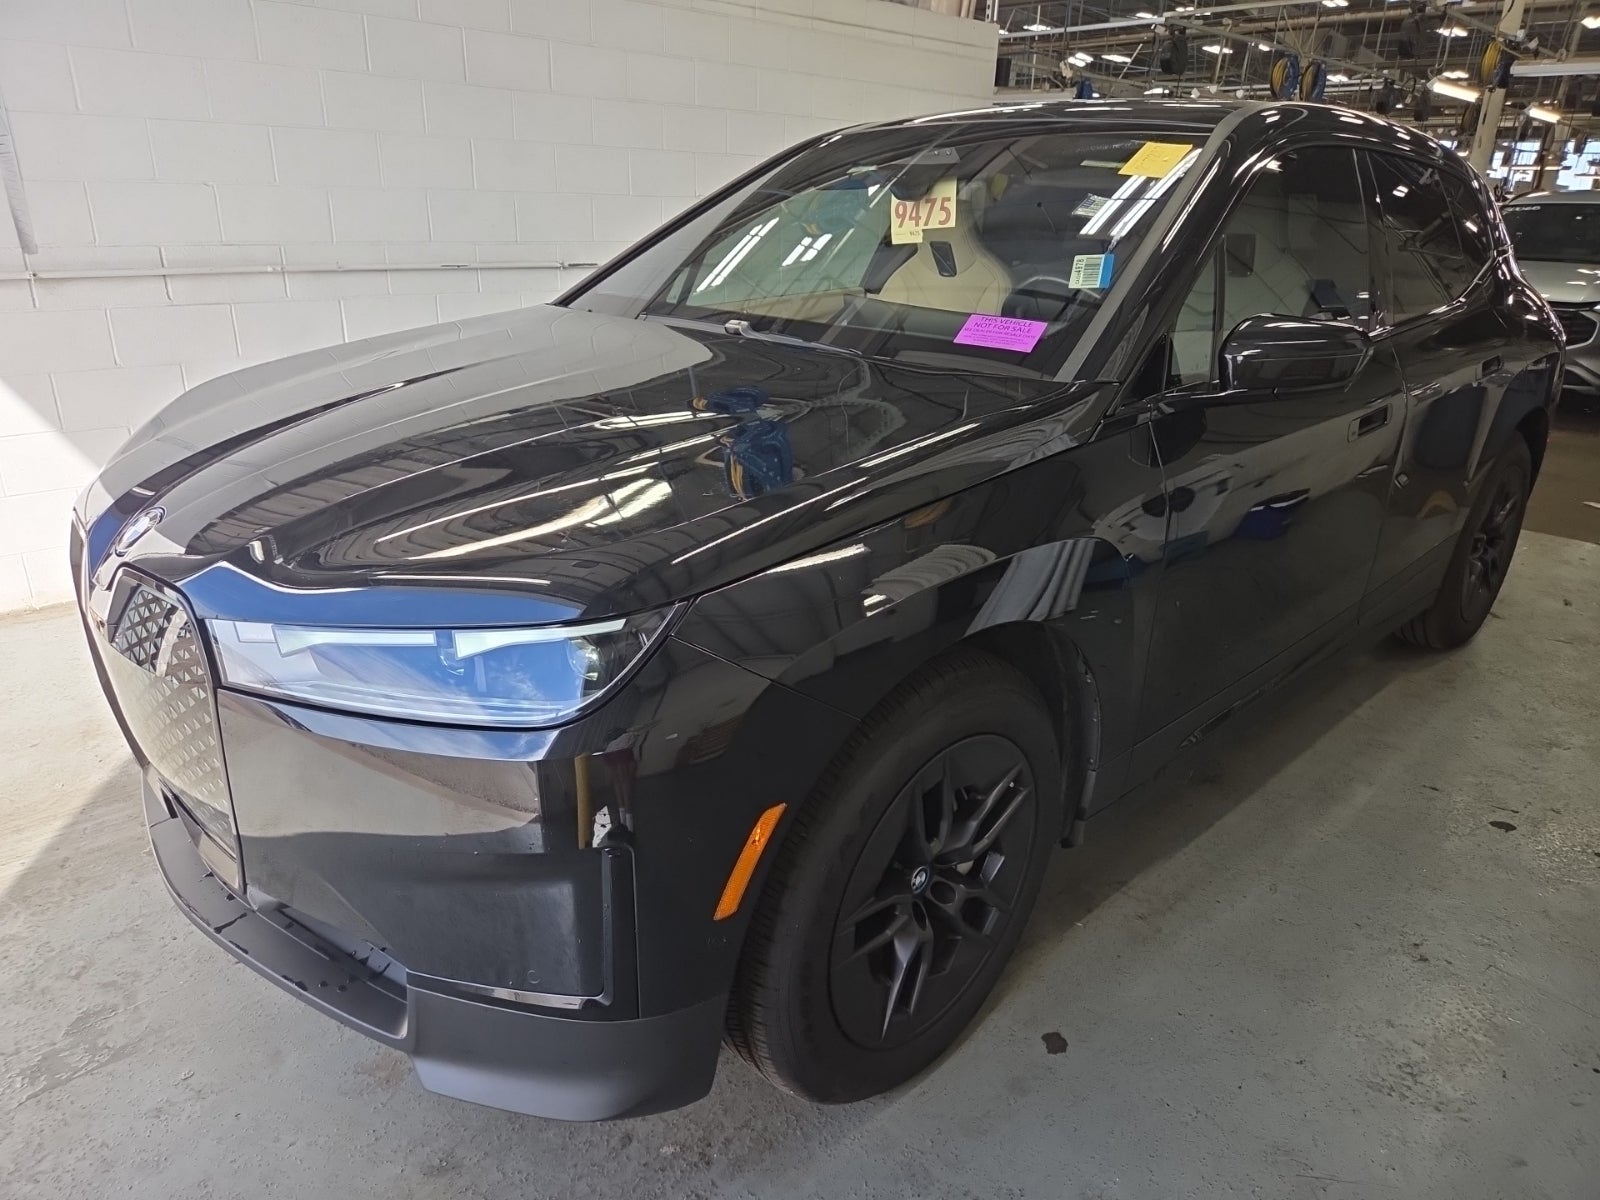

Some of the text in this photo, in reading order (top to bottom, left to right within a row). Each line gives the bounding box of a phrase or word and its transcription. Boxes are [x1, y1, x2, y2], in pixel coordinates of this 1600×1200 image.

[894, 196, 952, 228] 9475
[992, 323, 1011, 331] FOR
[1010, 326, 1032, 334] SALE
[1000, 319, 1032, 327] VEHICLE
